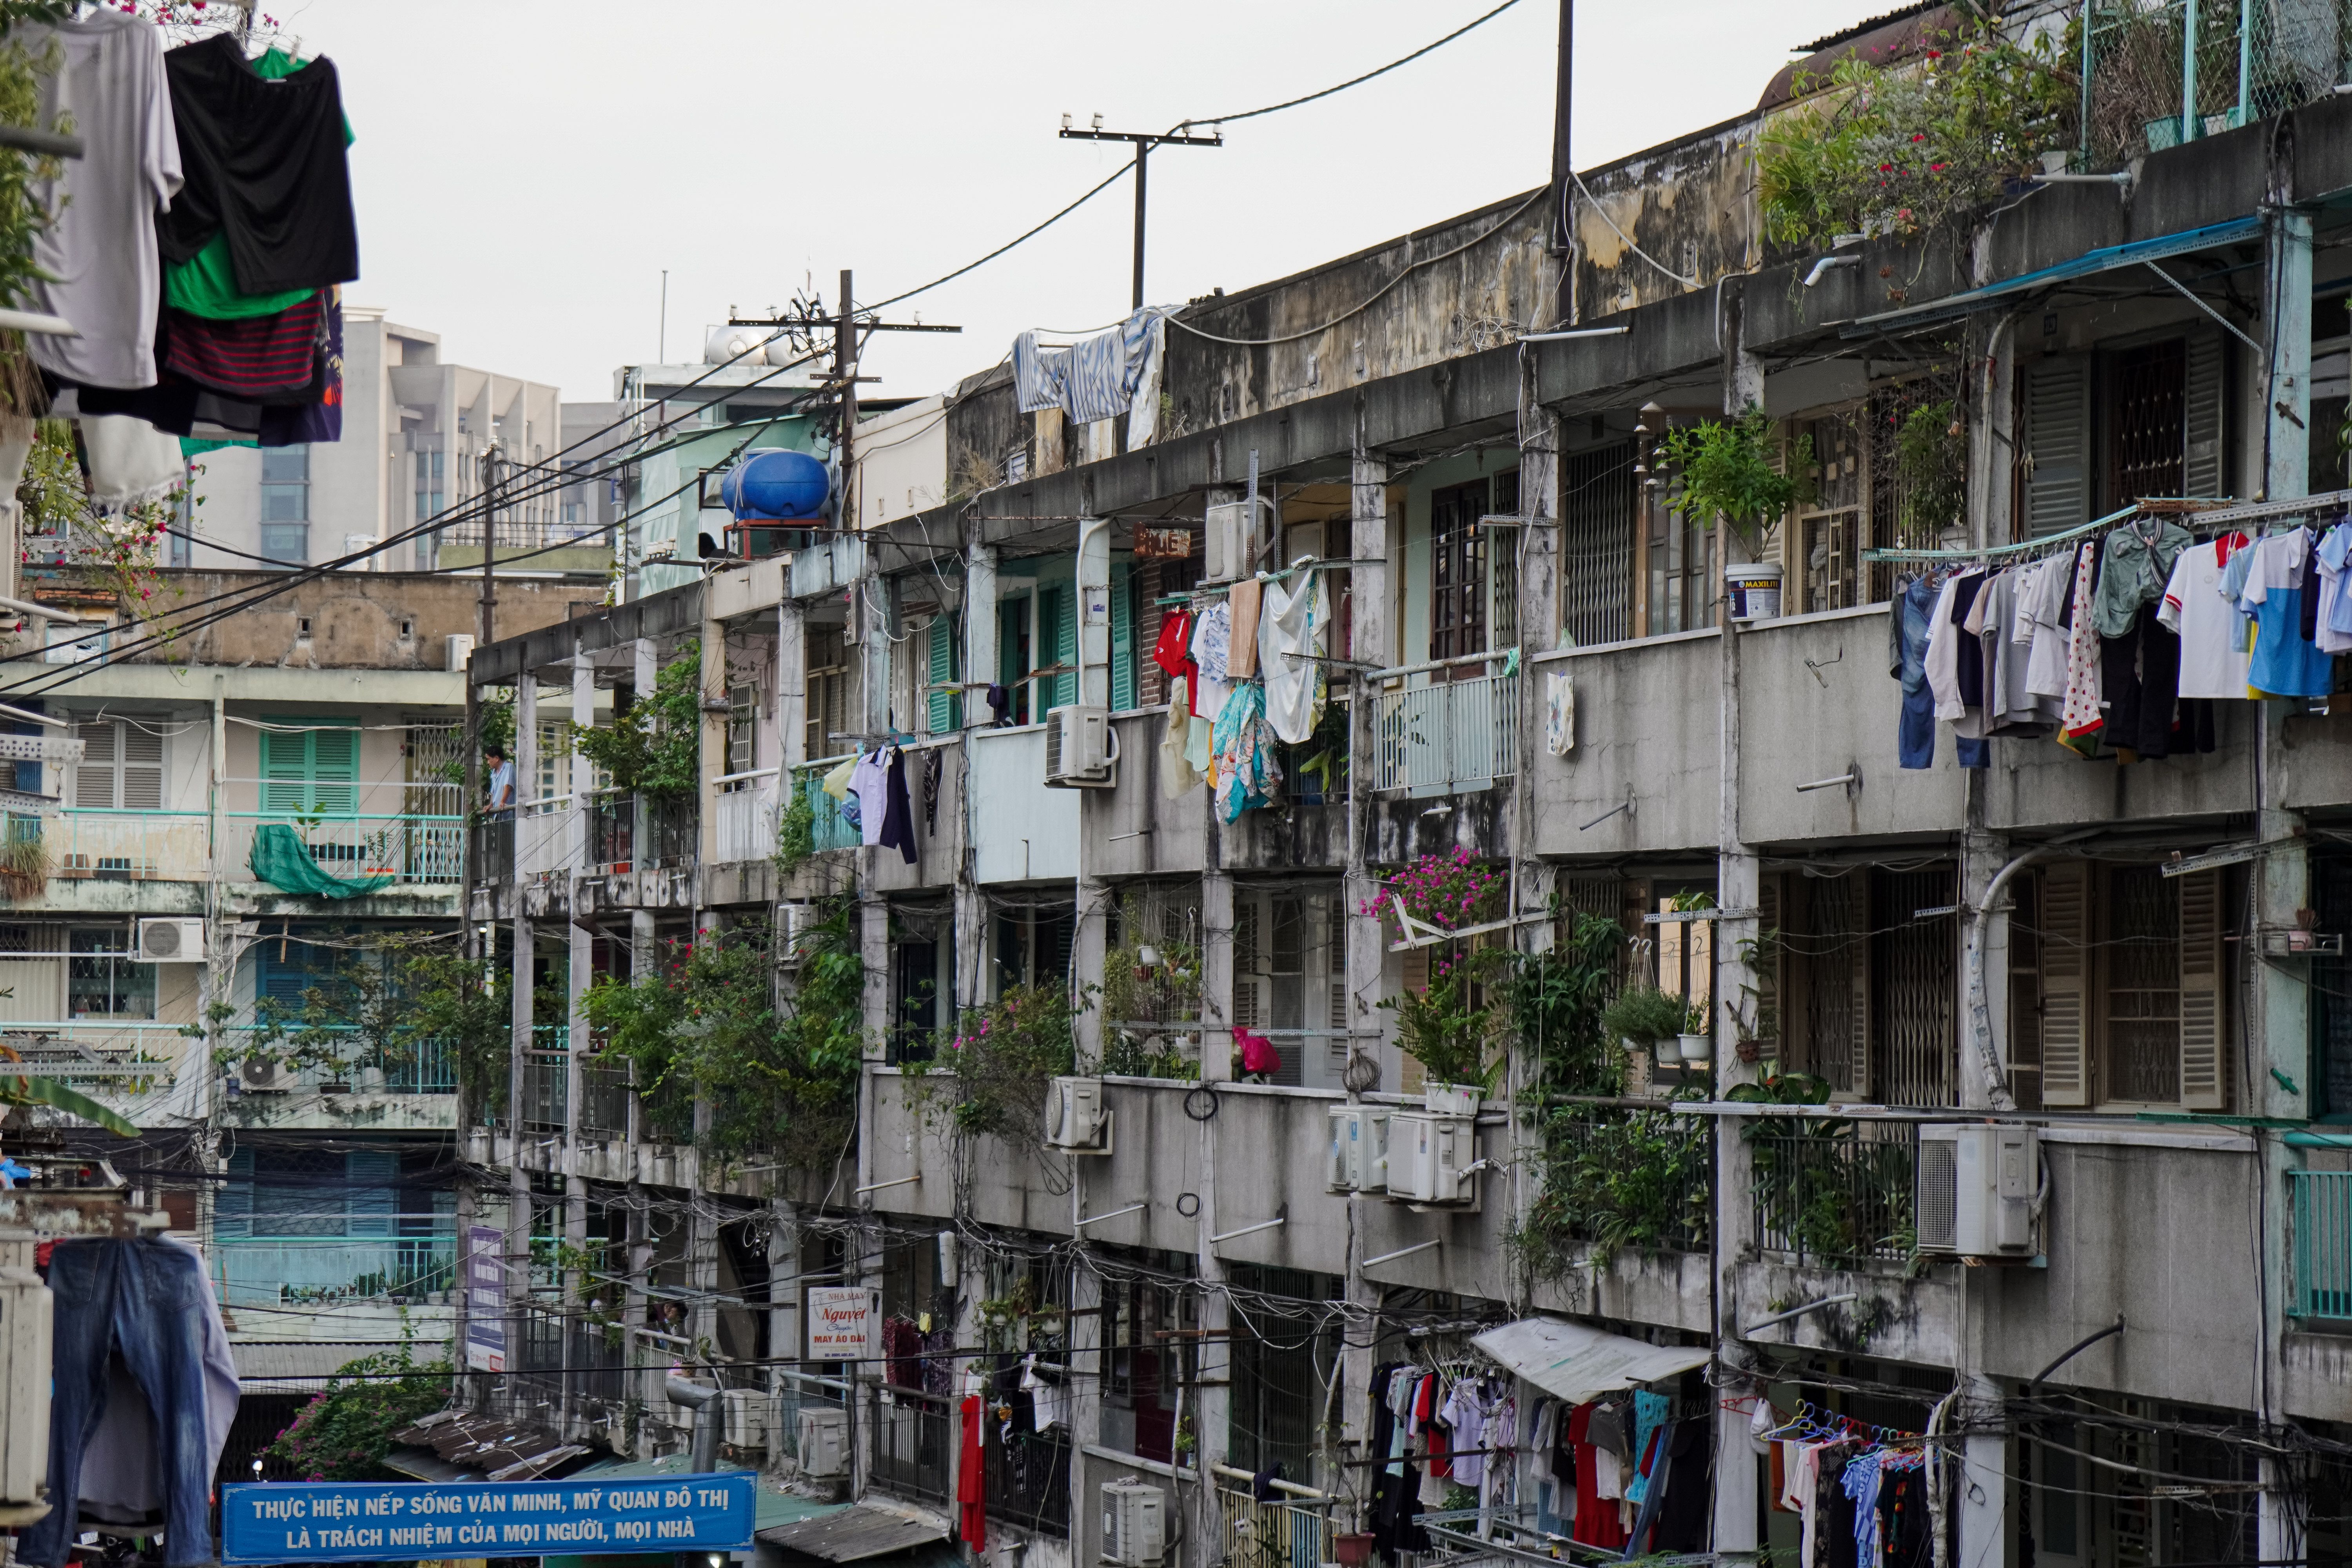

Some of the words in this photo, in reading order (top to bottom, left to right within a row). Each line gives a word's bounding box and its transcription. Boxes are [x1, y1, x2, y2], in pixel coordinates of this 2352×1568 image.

[836, 1334, 847, 1343] ÁO
[253, 1497, 305, 1521] THỰC
[313, 1495, 358, 1520] HIỆN
[366, 1491, 405, 1515] NẾP
[411, 1490, 462, 1514] SỐNG
[468, 1492, 506, 1512] VĂN
[513, 1494, 566, 1513] MINH,
[574, 1489, 602, 1509] MỸ
[609, 1491, 659, 1512] QUAN
[665, 1486, 691, 1507] ĐÔ
[698, 1490, 728, 1510] THỊ
[287, 1526, 310, 1548] LÀ
[318, 1525, 382, 1547] TRÁCH
[390, 1523, 452, 1548] NHIỆM
[459, 1519, 496, 1543] CỦA
[504, 1524, 539, 1544] MỌI
[546, 1519, 608, 1543] NGƯỜI,
[616, 1522, 651, 1542] MỌI
[658, 1516, 695, 1537] NHÀ
